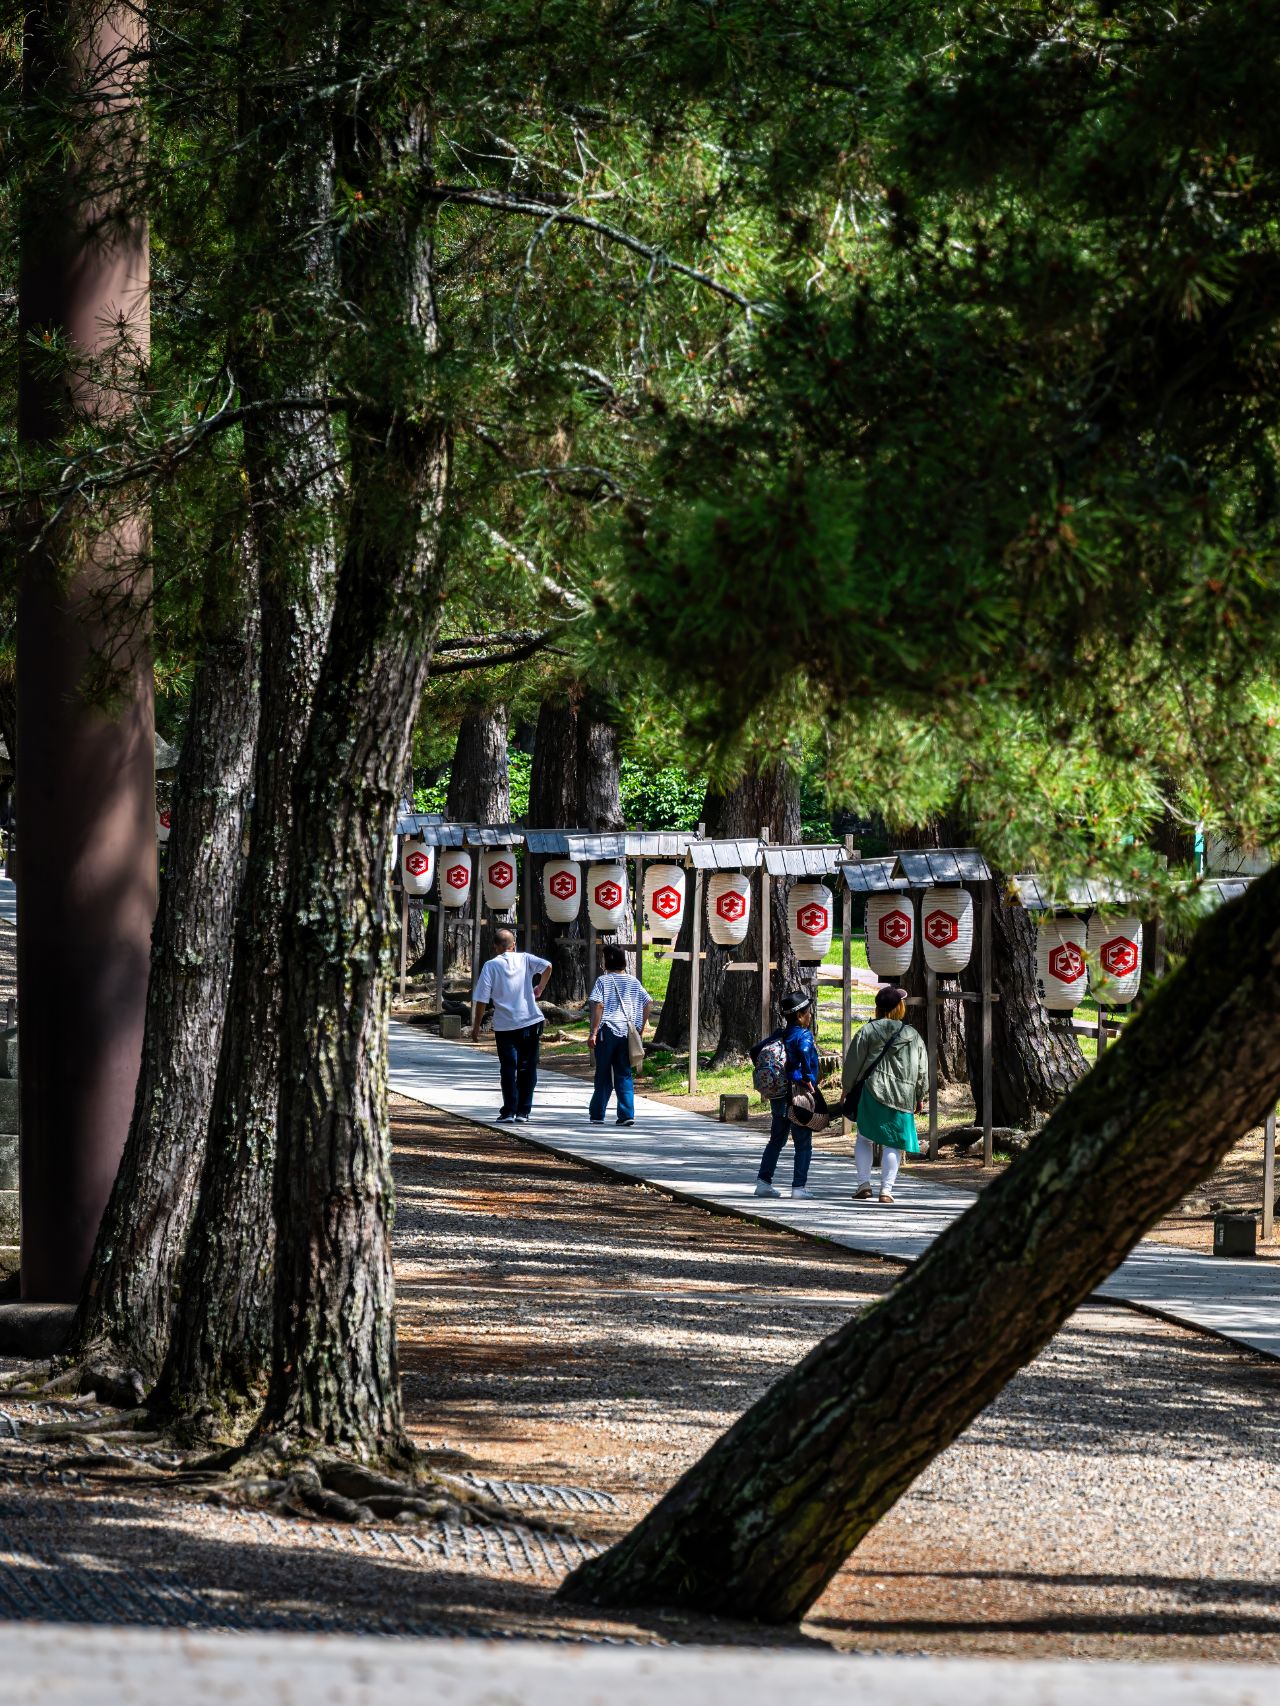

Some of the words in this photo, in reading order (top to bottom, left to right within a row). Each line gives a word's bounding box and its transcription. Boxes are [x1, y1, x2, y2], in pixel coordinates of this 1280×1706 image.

[660, 894, 675, 910] 大
[724, 898, 739, 914] 大
[804, 910, 821, 927] 大
[887, 918, 906, 938] 大
[932, 919, 950, 938] 大
[1111, 946, 1131, 967] 大
